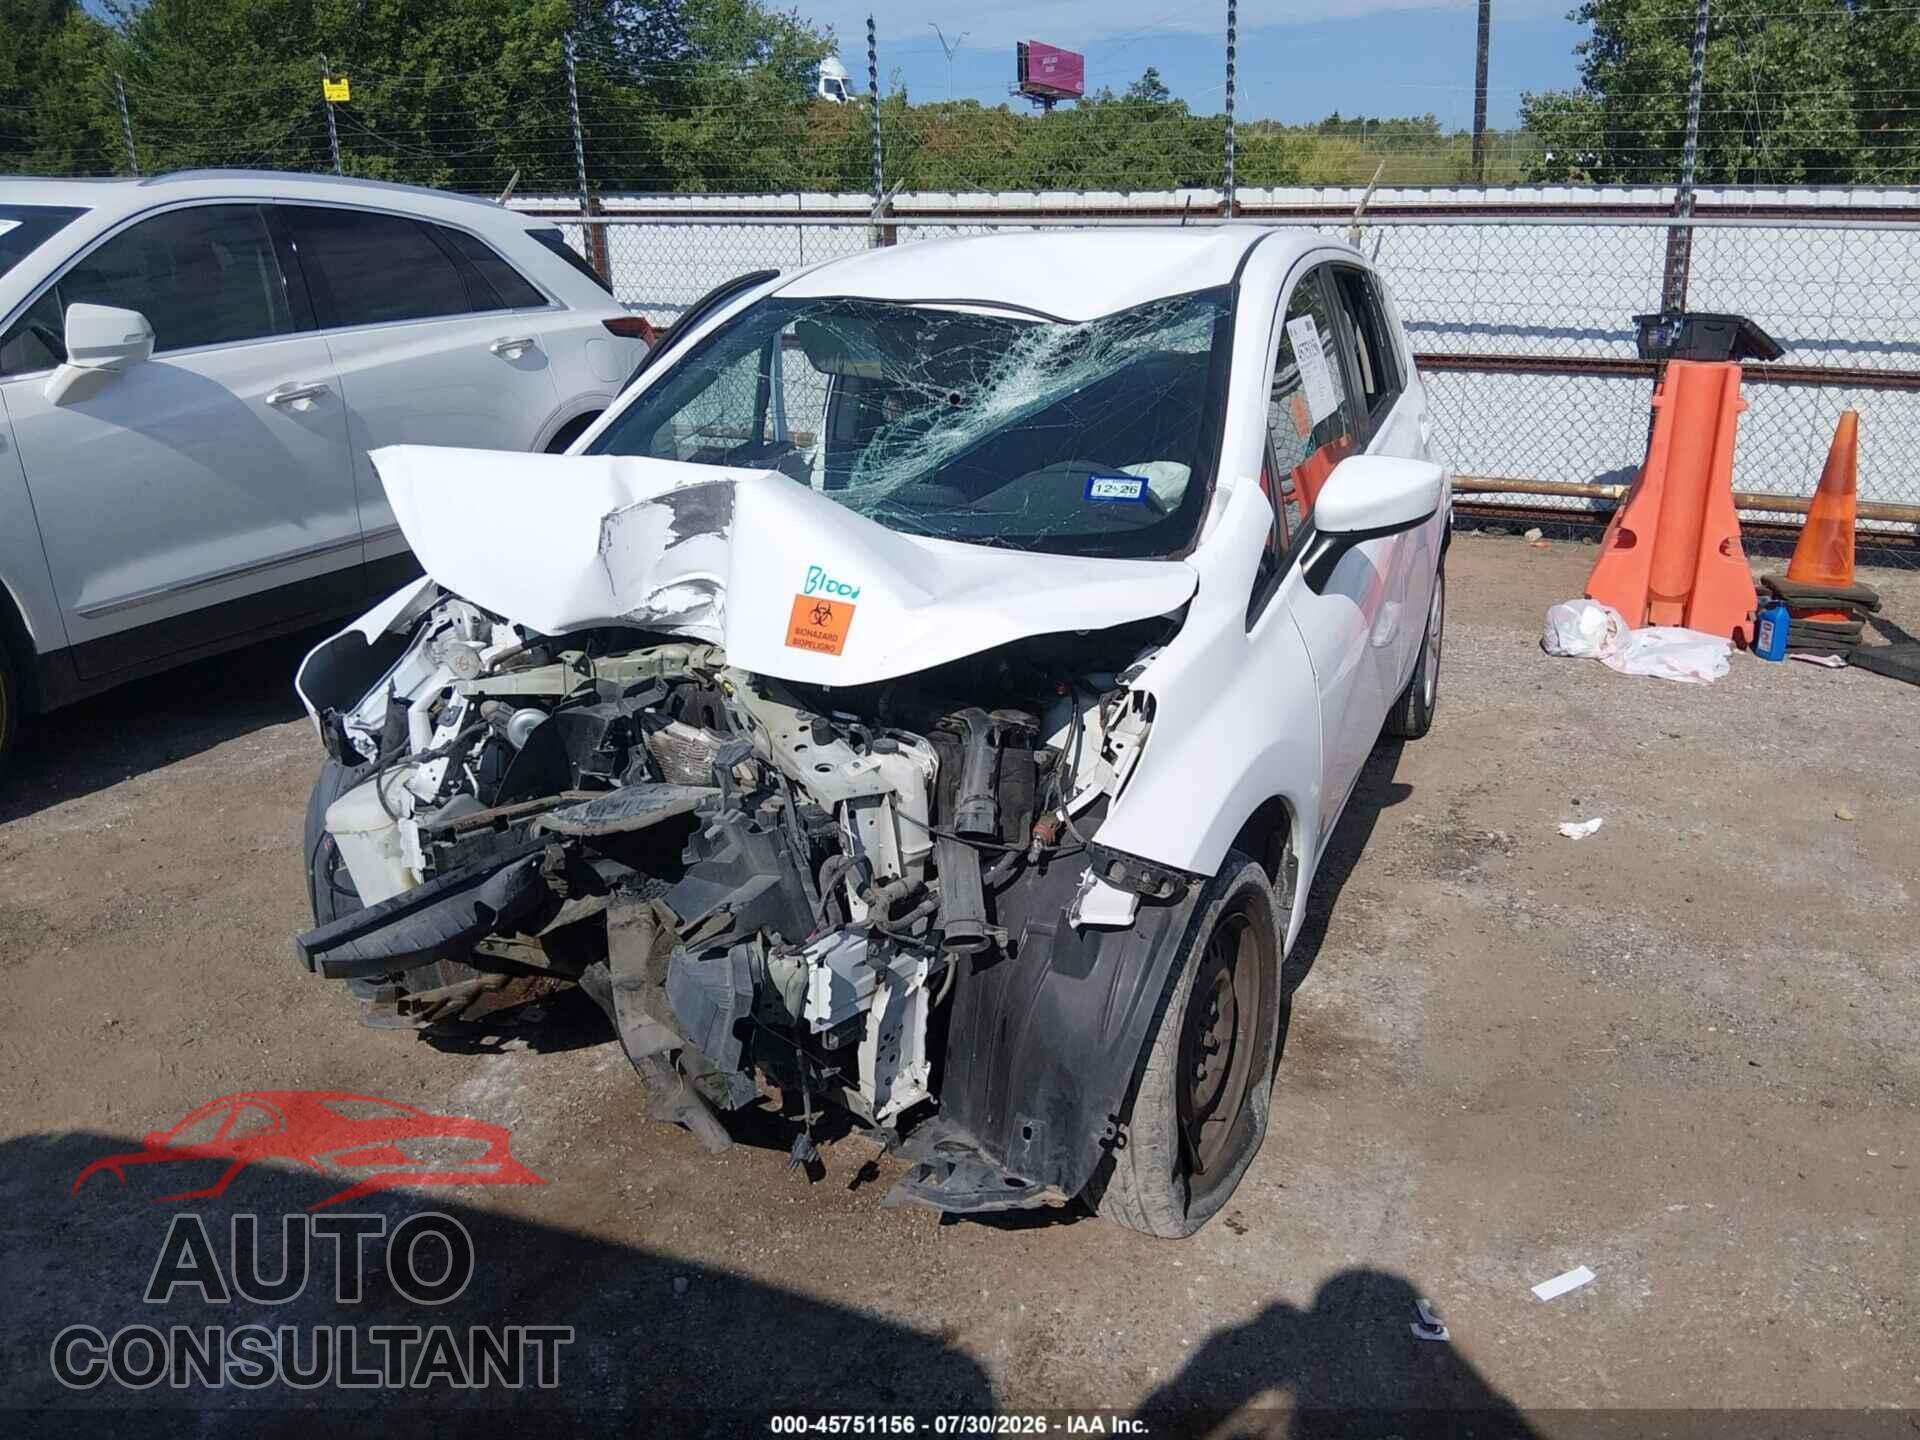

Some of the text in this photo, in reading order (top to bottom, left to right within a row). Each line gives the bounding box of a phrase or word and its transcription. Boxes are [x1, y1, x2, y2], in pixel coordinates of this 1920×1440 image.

[1095, 484, 1138, 495] 12 26
[803, 565, 861, 599] Blood
[795, 627, 839, 642] BIOHAZARD
